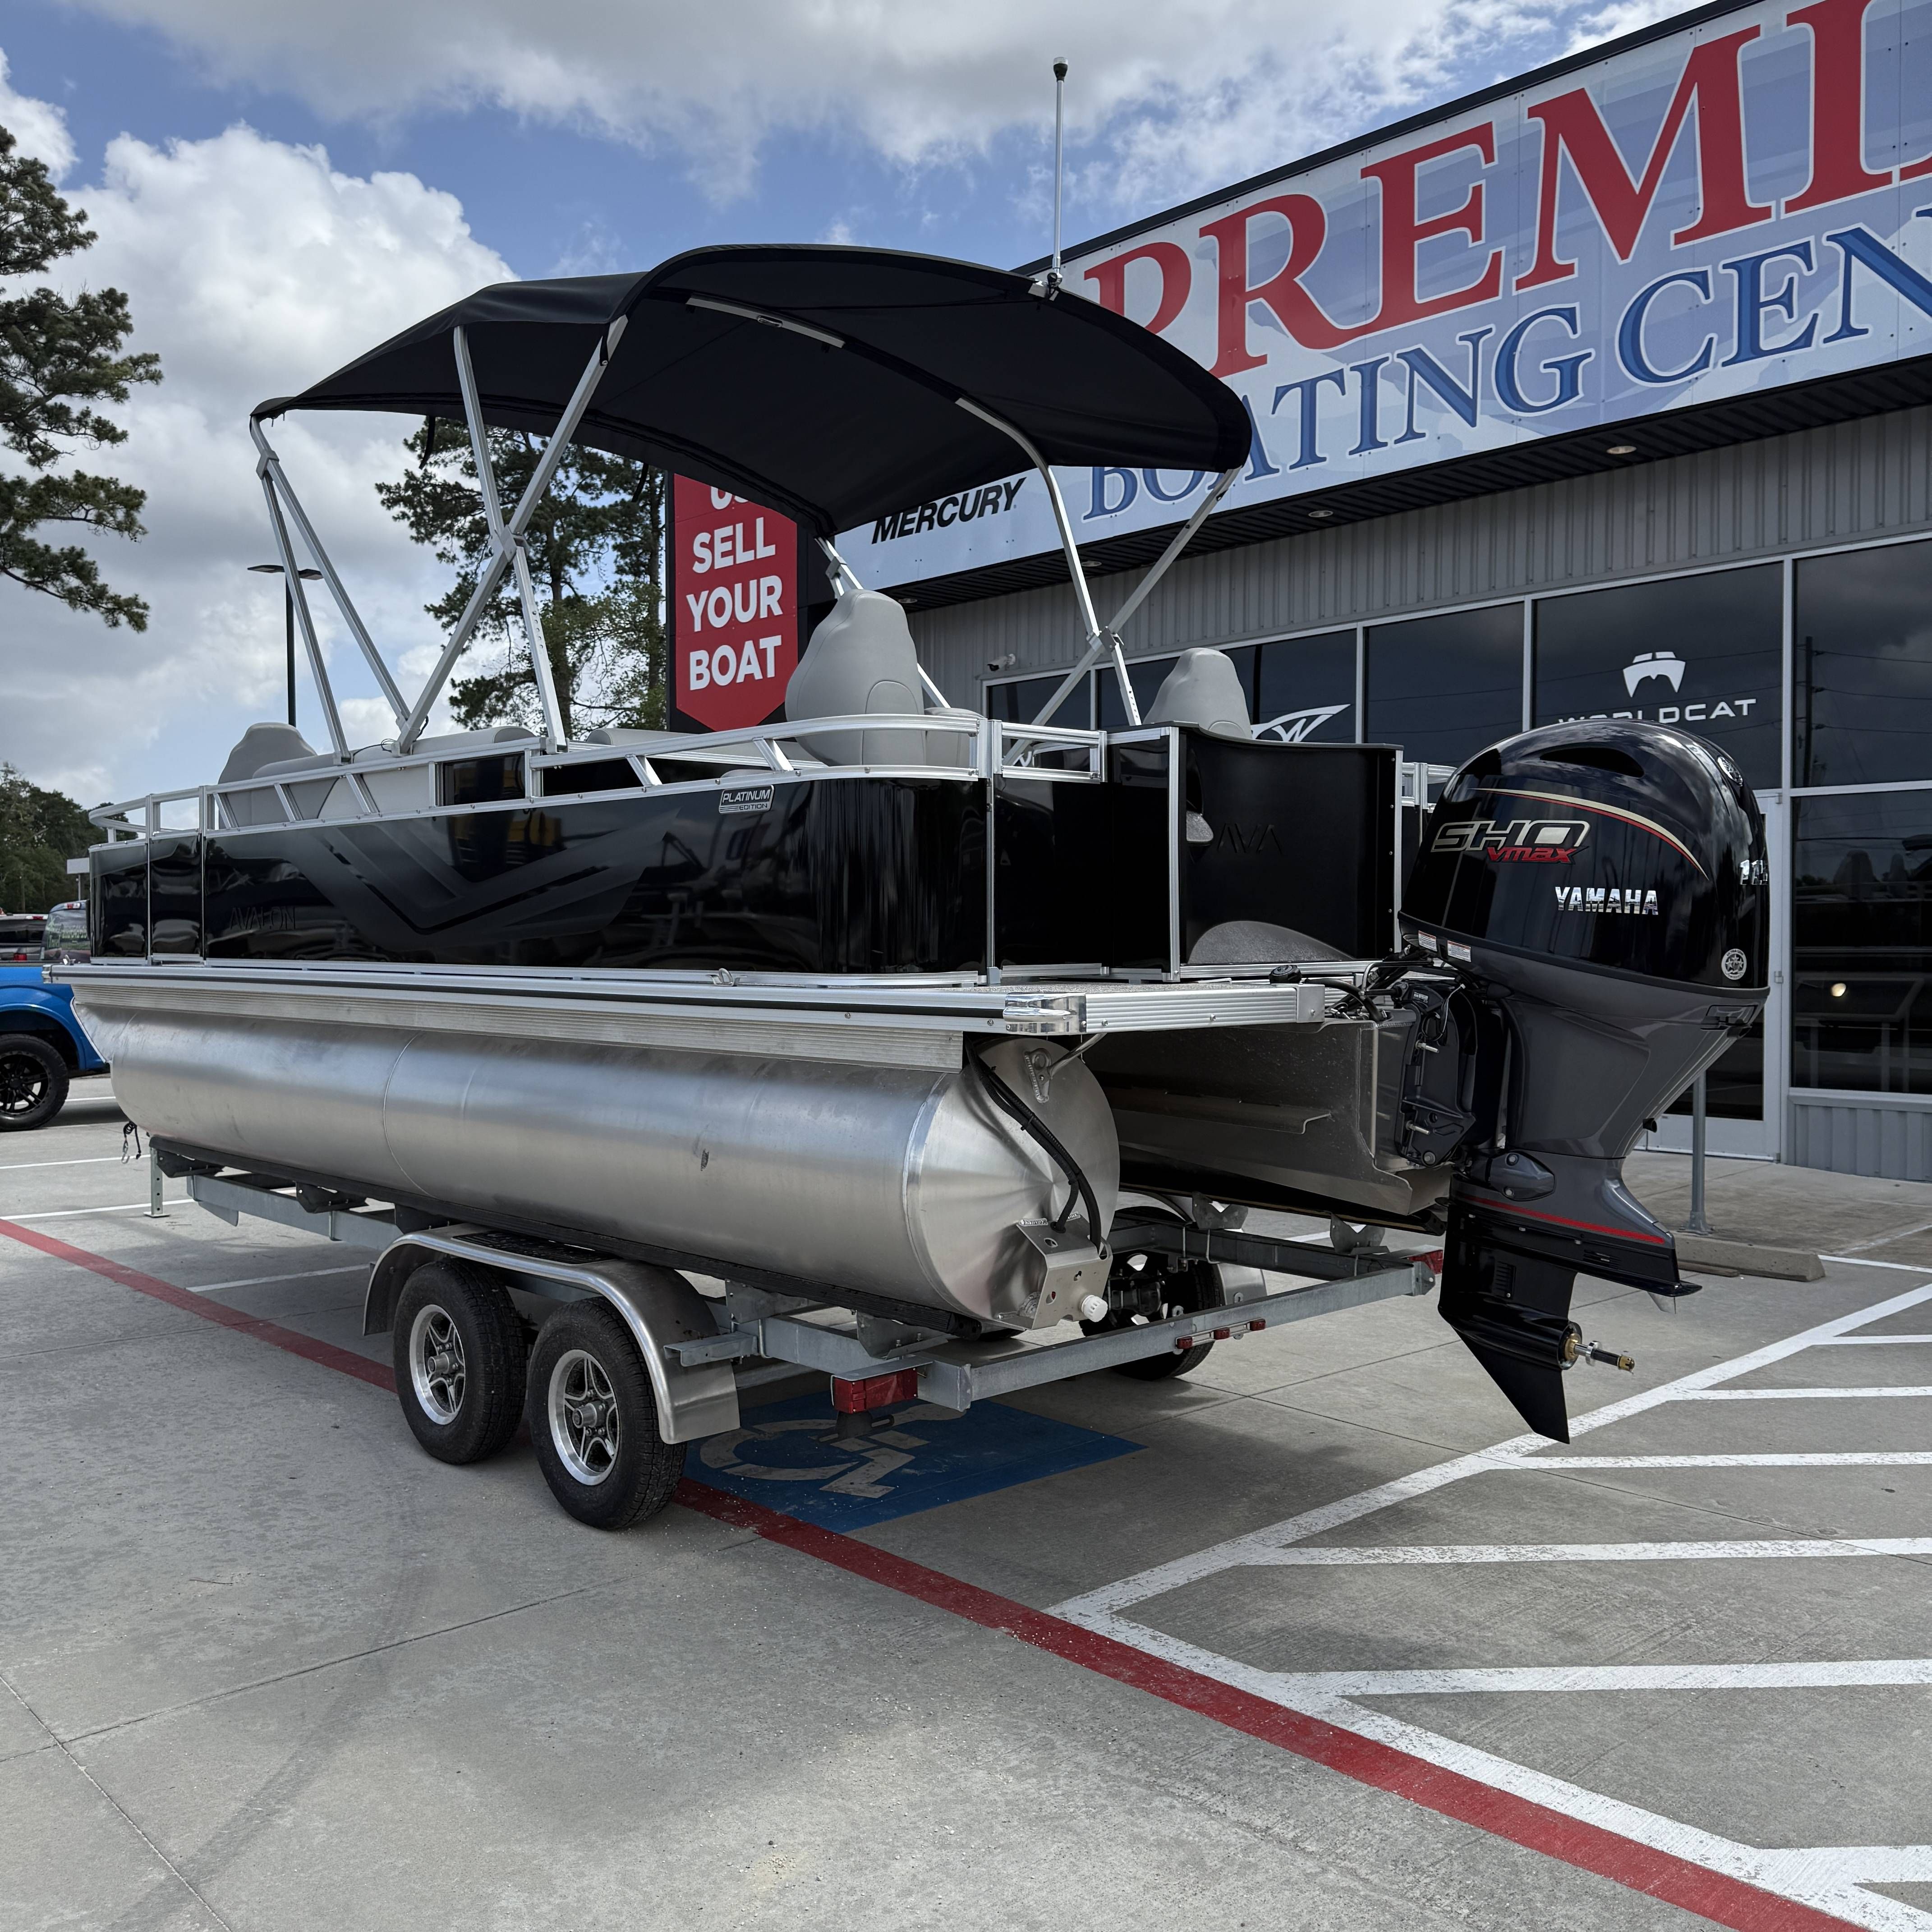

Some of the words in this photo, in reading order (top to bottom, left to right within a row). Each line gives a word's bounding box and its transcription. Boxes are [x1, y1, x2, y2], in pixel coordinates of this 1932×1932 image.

[1085, 0, 1932, 380] PREMI
[711, 486, 749, 510] U
[872, 477, 1027, 545] MERCURY
[693, 517, 776, 574] SELL
[686, 575, 783, 632] YOUR
[690, 635, 782, 690] BOAT
[1559, 699, 1756, 723] LDCAT
[722, 789, 771, 803] PLATINUM
[1431, 820, 1591, 853] SHO
[1555, 886, 1659, 915] YAMAHA
